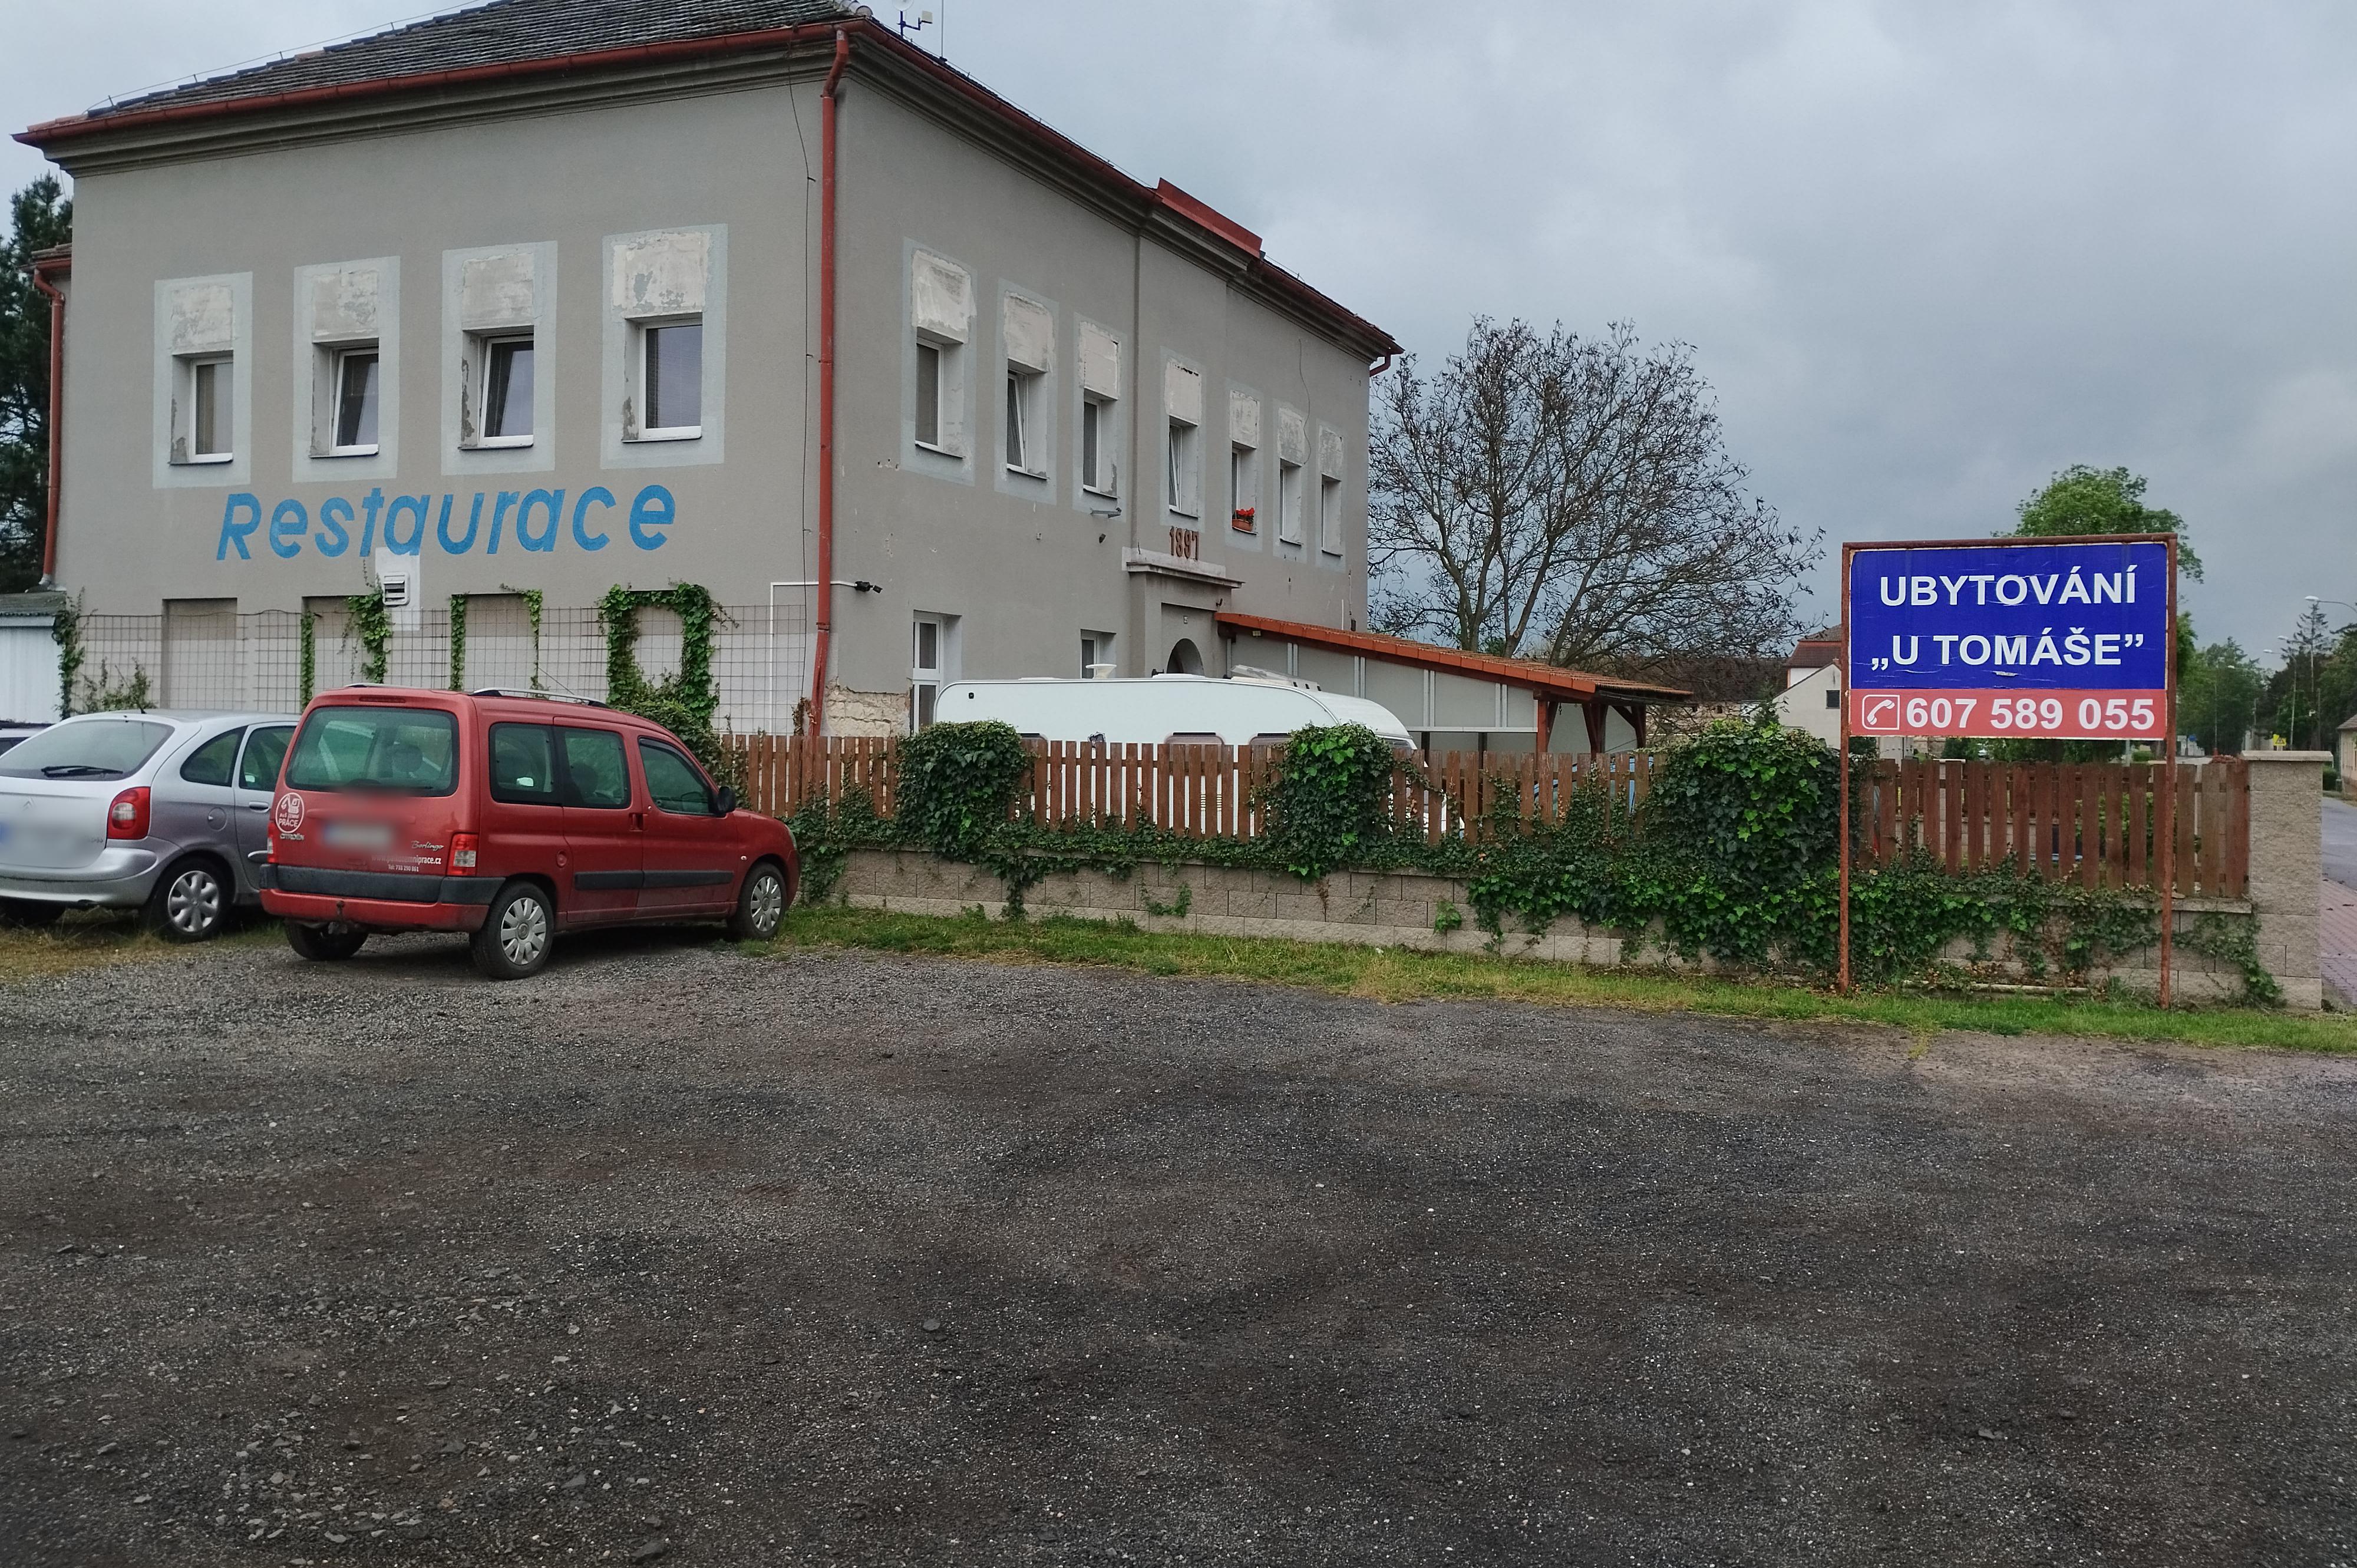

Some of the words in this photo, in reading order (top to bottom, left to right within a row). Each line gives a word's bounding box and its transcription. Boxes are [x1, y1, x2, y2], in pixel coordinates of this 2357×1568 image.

[216, 484, 676, 560] Restaurace
[1169, 526, 1200, 561] 1897
[1880, 565, 2138, 606] UBYTOVÁNÍ
[1906, 698, 1977, 728] 607
[1990, 698, 2063, 729] 589
[2079, 699, 2154, 730] 055
[411, 840, 444, 851] Berlingo
